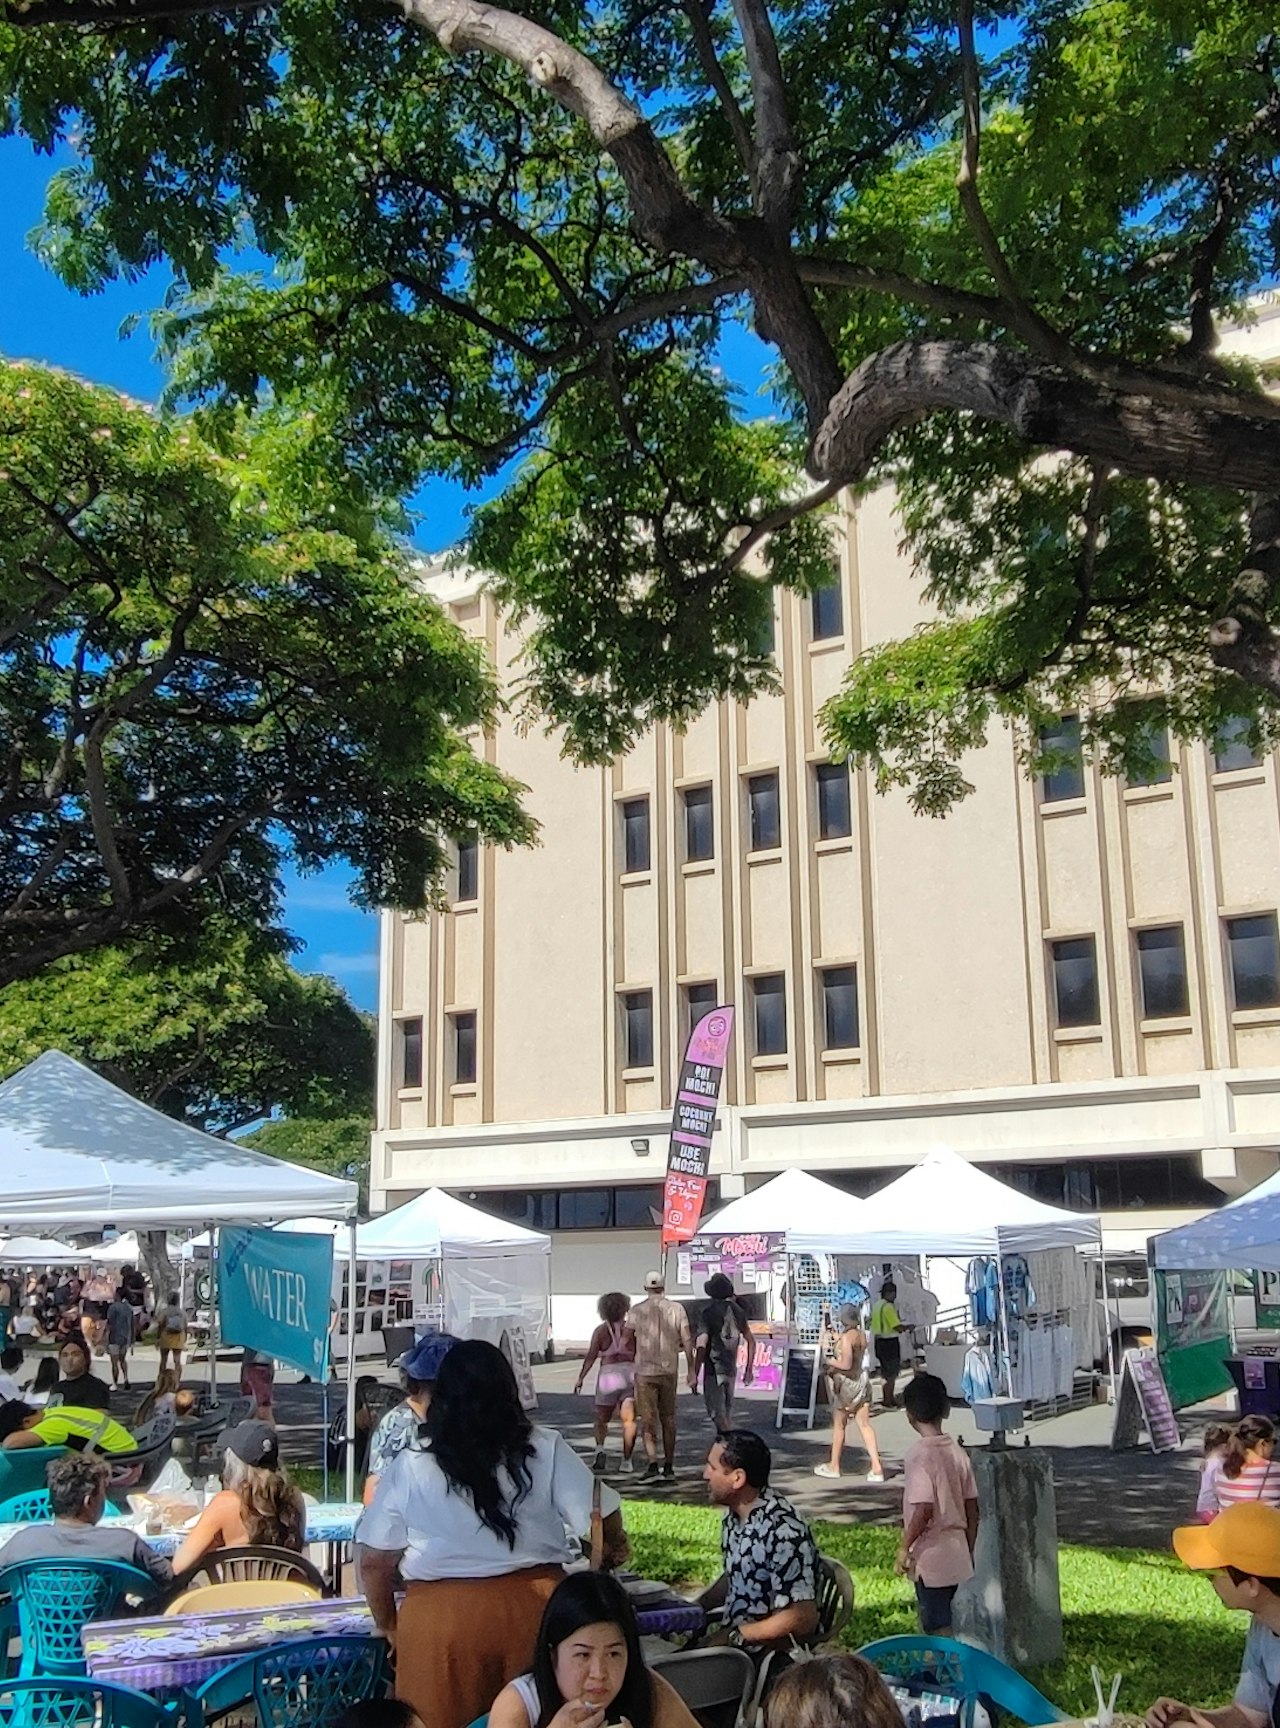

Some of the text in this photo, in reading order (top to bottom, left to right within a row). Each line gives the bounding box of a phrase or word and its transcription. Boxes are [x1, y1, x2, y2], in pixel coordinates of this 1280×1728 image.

[685, 1076, 716, 1095] MOCHI
[682, 1117, 708, 1133] MOCHI
[680, 1144, 701, 1160] UBE
[670, 1155, 705, 1176] MOCHI
[243, 1262, 310, 1332] WATER
